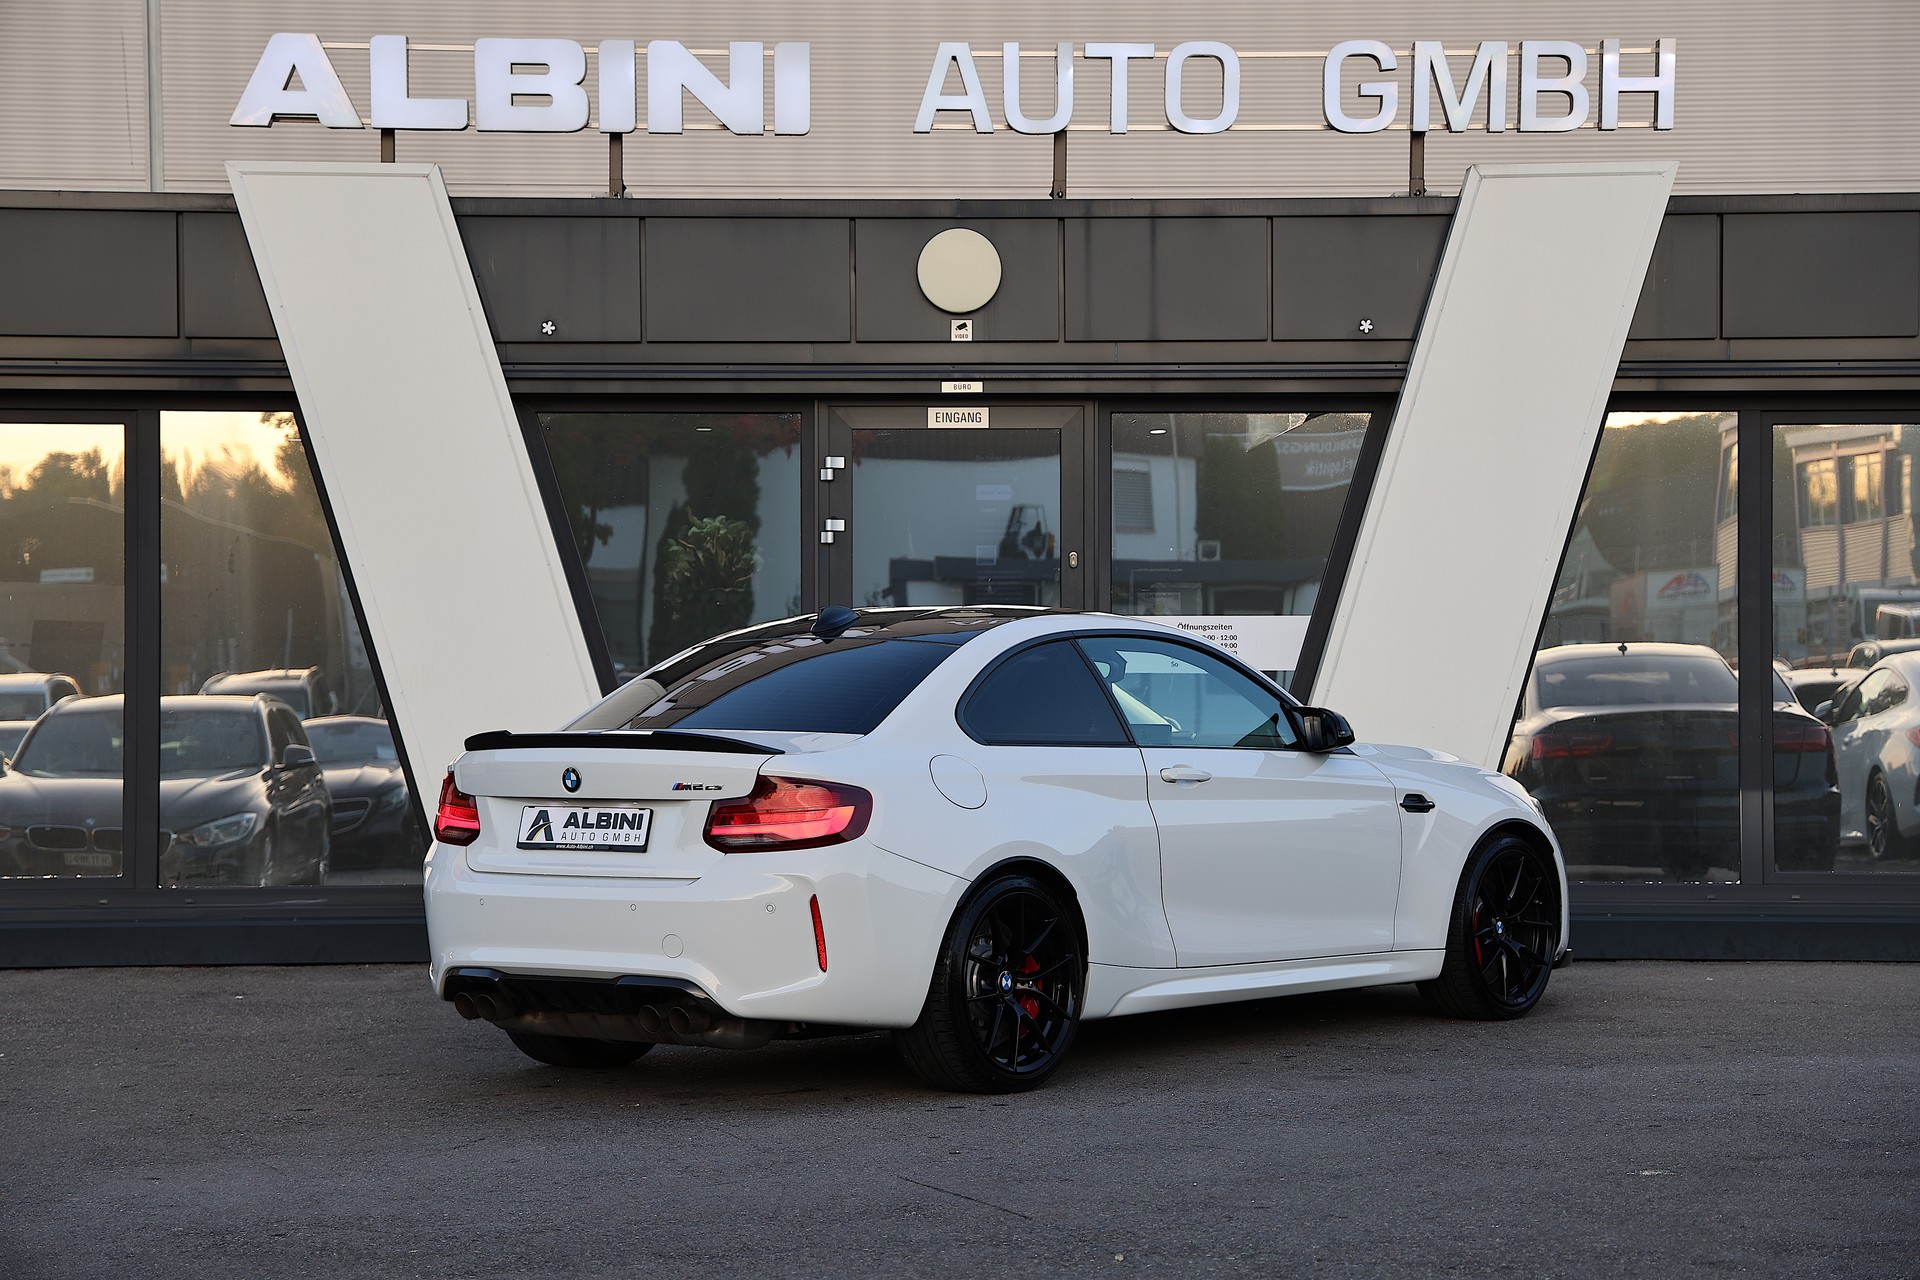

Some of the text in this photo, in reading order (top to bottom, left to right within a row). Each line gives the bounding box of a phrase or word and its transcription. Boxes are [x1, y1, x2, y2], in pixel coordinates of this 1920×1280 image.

[230, 33, 1676, 136] ALBINI AUTO GMBH
[935, 412, 982, 423] EINGANG
[1177, 622, 1233, 632] Öffnungszeiten
[563, 812, 644, 831] ALBINI
[561, 832, 641, 843] AUTO GMBH
